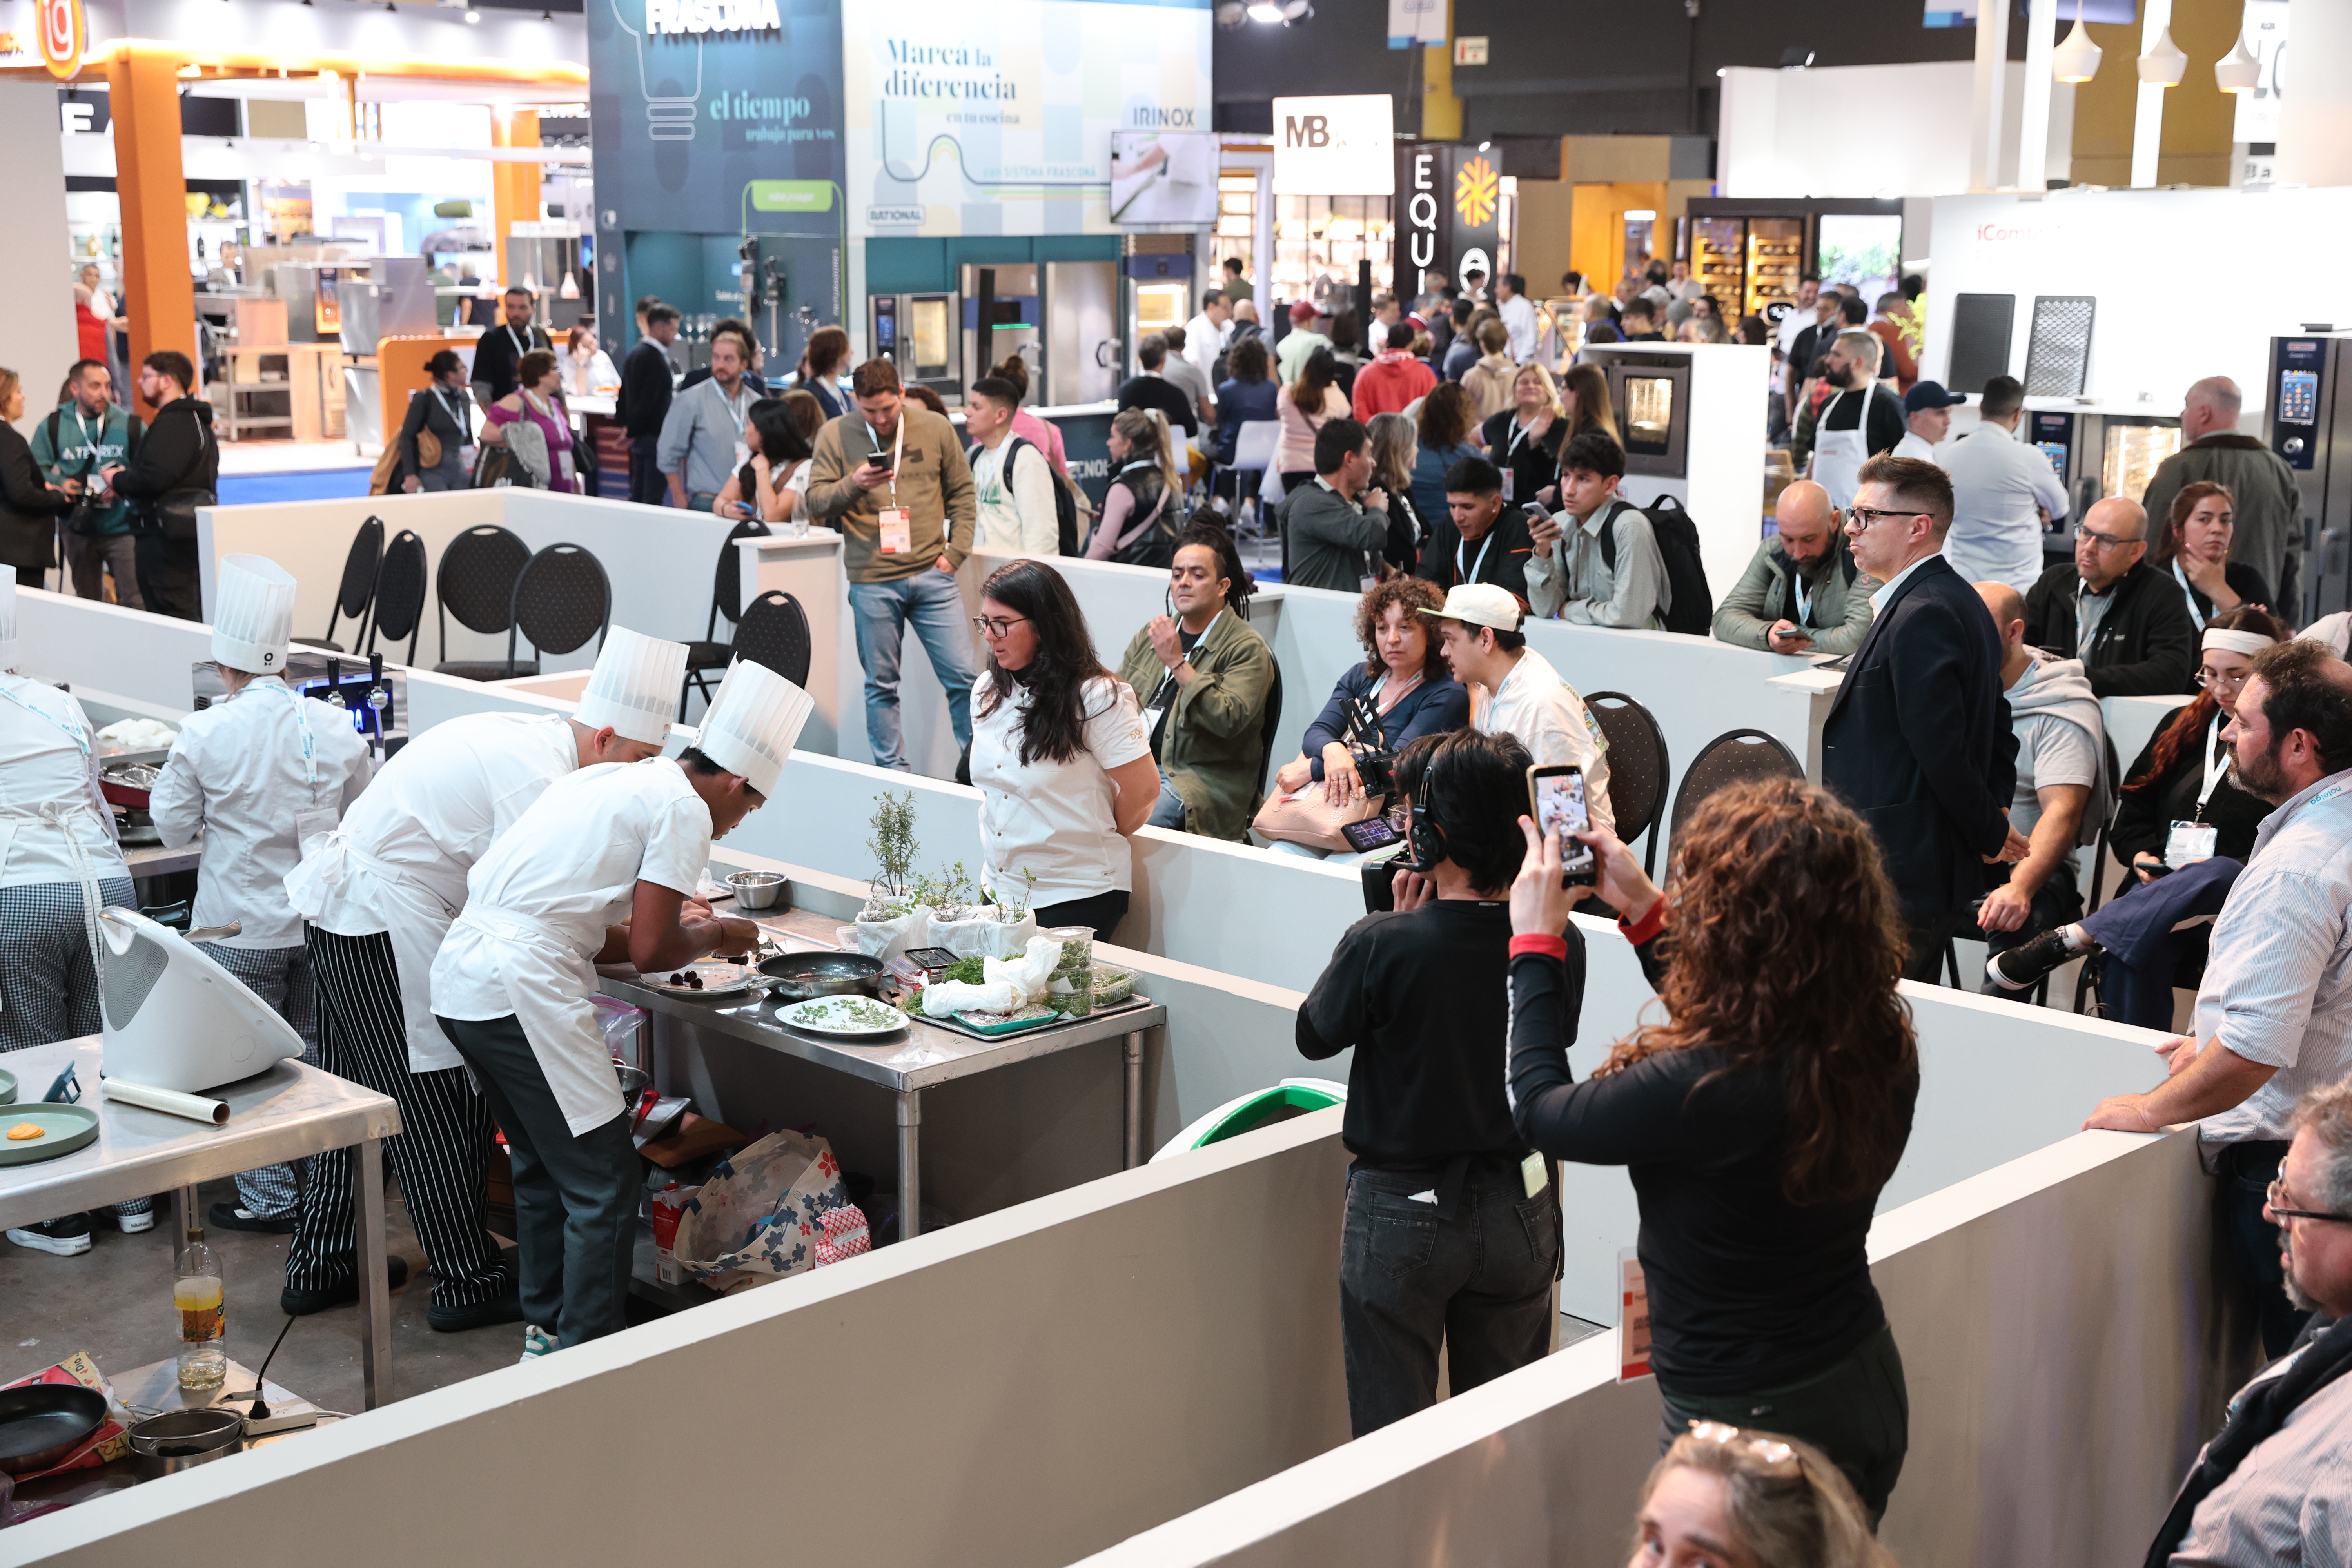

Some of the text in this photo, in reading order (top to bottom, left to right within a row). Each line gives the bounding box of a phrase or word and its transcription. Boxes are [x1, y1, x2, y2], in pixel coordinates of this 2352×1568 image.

[976, 48, 991, 65] la
[885, 70, 1016, 99] diferencia
[710, 89, 811, 126] el tiempo
[1133, 107, 1194, 127] IRINOX
[1499, 678, 1511, 696] hotelga
[29, 704, 51, 720] hotelga
[2310, 786, 2342, 805] hotelga
